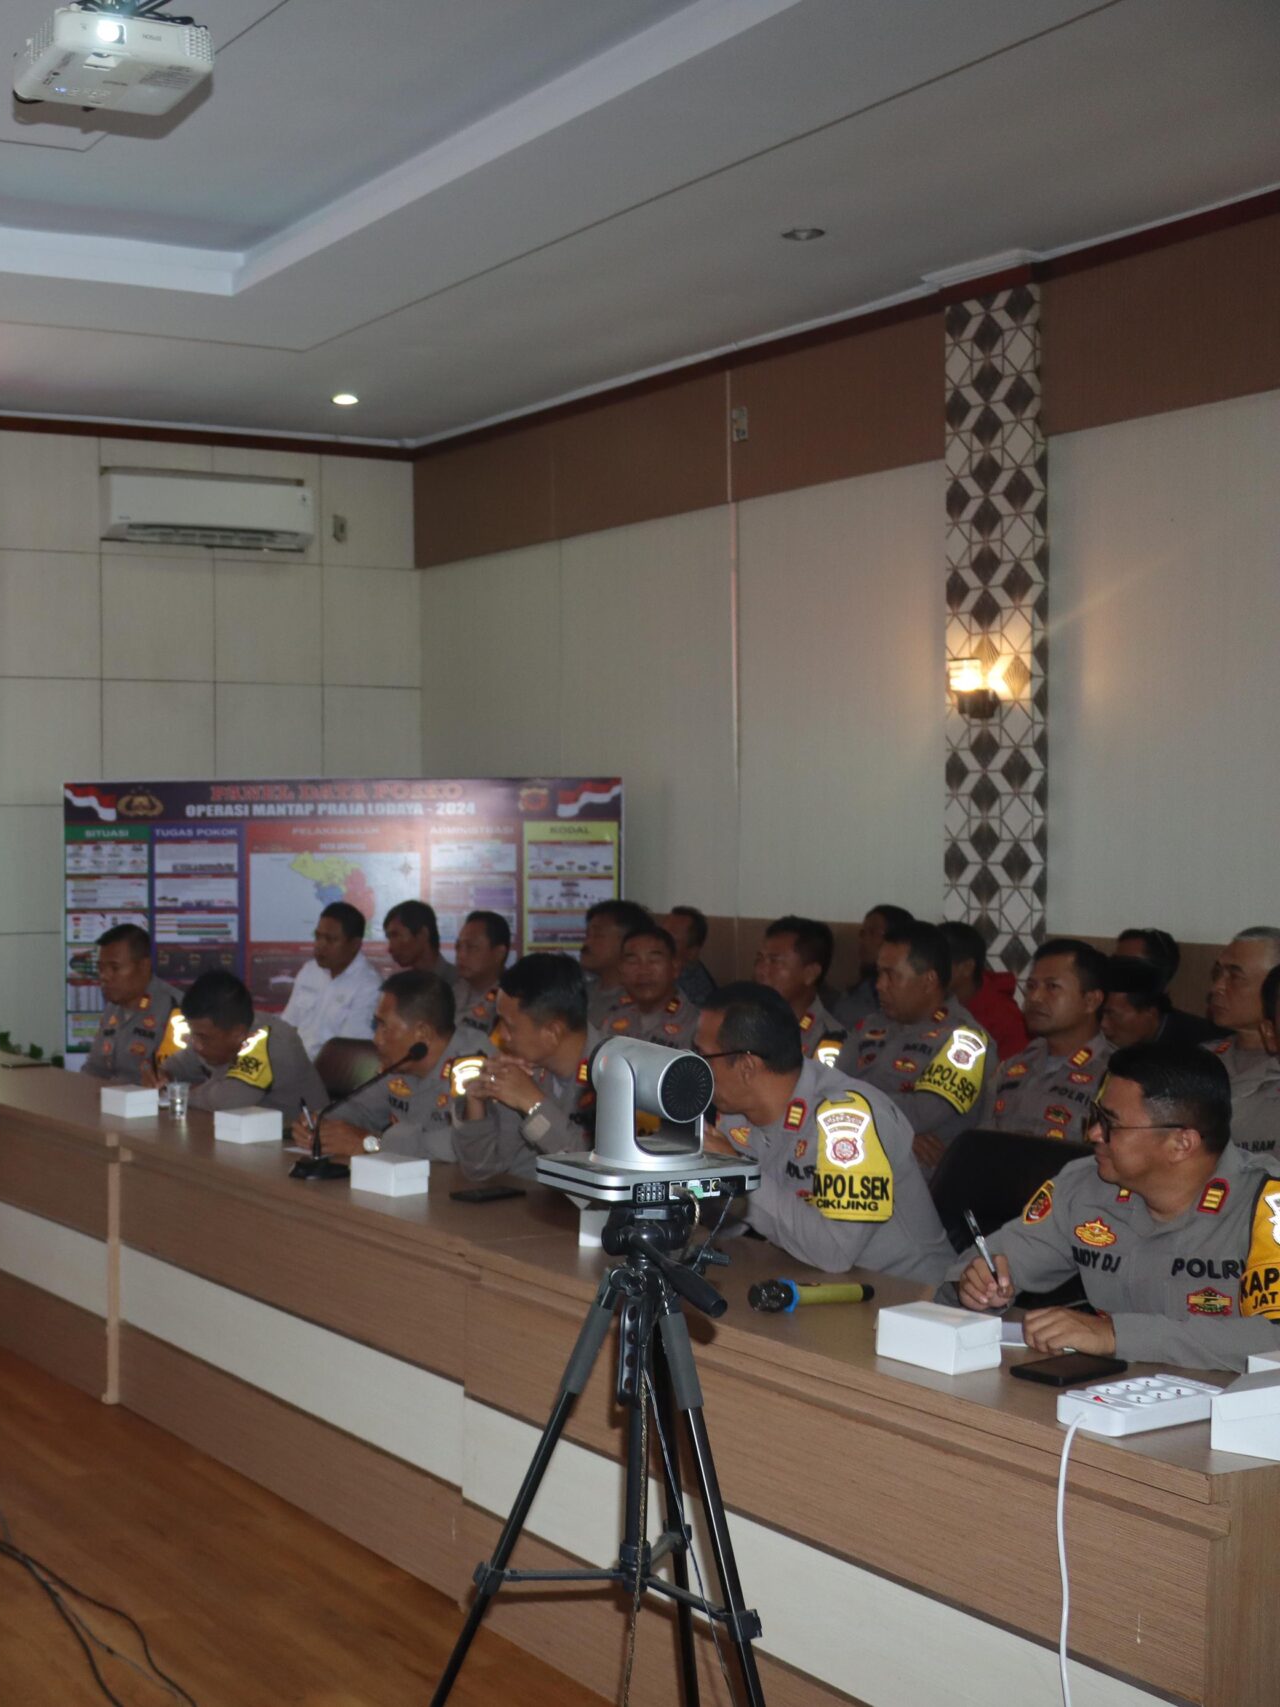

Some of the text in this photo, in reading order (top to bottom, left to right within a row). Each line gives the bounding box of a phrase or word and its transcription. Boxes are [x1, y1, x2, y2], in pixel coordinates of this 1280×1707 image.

[210, 785, 294, 801] PANEL
[185, 804, 249, 817] OPERASI
[252, 803, 315, 817] MANTAP
[318, 802, 365, 816] PRAJA
[435, 801, 476, 815] 2024
[85, 829, 129, 838] SITUASI
[155, 828, 238, 837] TUGAS POKOK
[922, 1062, 977, 1102] APOLSEK
[1050, 1086, 1091, 1106] POLRI
[813, 1173, 890, 1201] APOLSEK
[816, 1200, 879, 1211] CIKIJING
[1101, 1253, 1122, 1273] DJ
